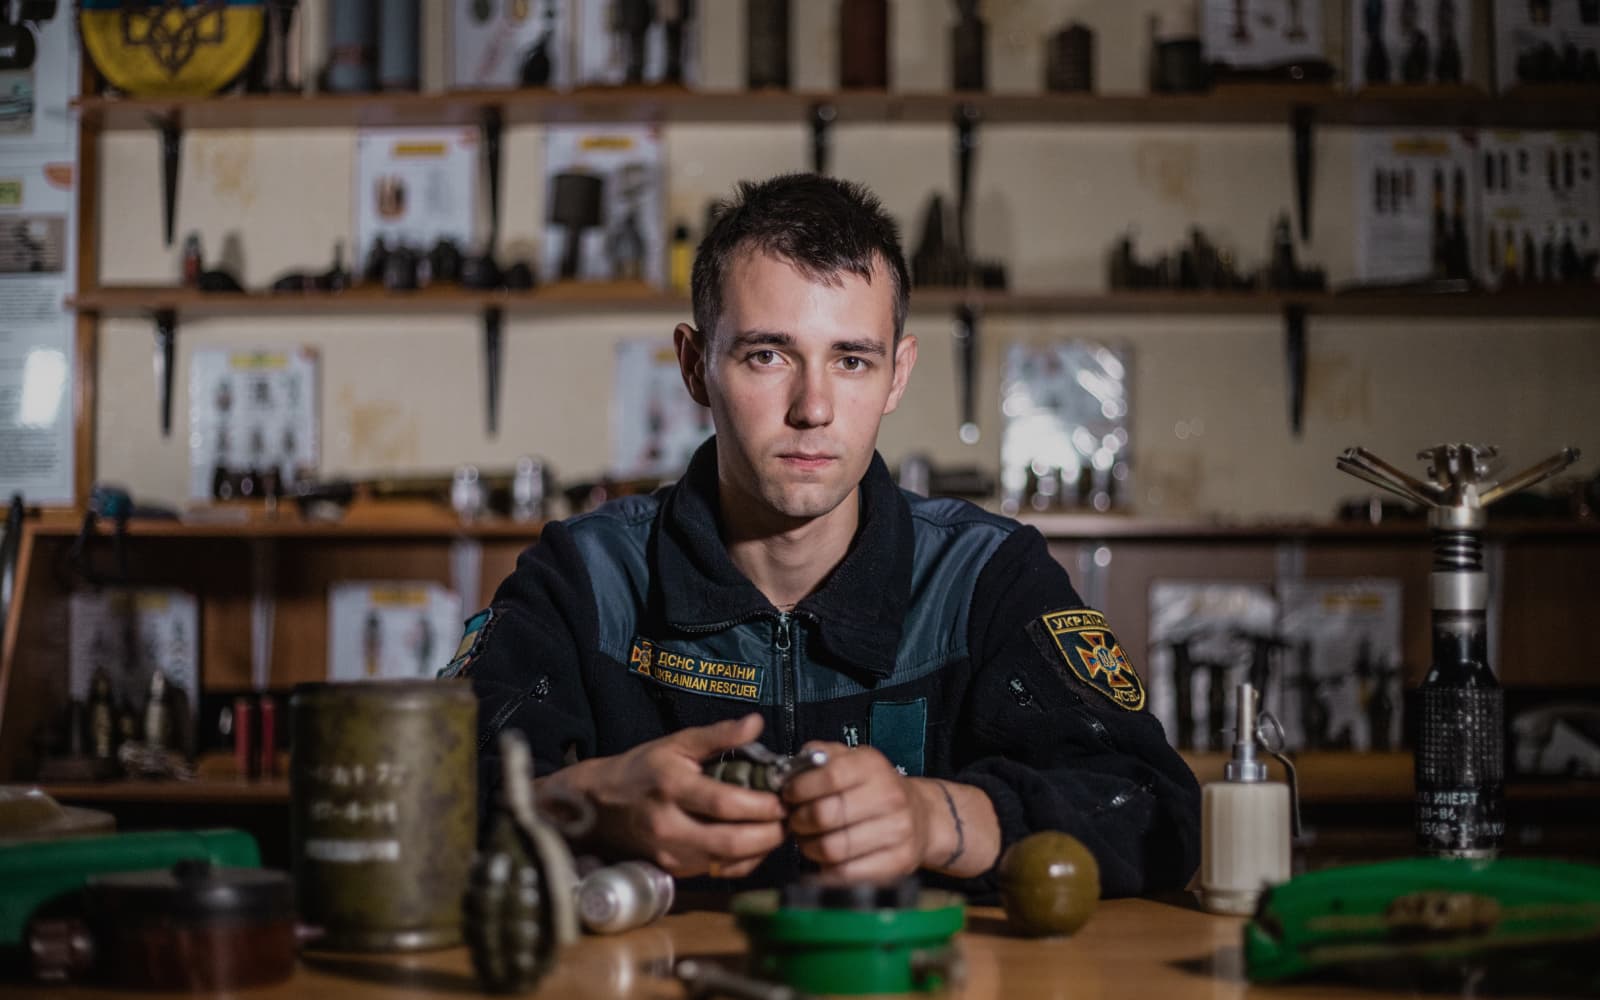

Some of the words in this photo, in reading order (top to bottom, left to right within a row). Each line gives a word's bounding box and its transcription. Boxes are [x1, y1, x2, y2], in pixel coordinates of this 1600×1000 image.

[1051, 614, 1104, 630] УКРАЇН
[658, 651, 695, 671] ДСНС
[699, 660, 756, 681] УКРАЇНИ
[654, 666, 708, 692] UKRAINIAN
[709, 680, 757, 698] RESCUER
